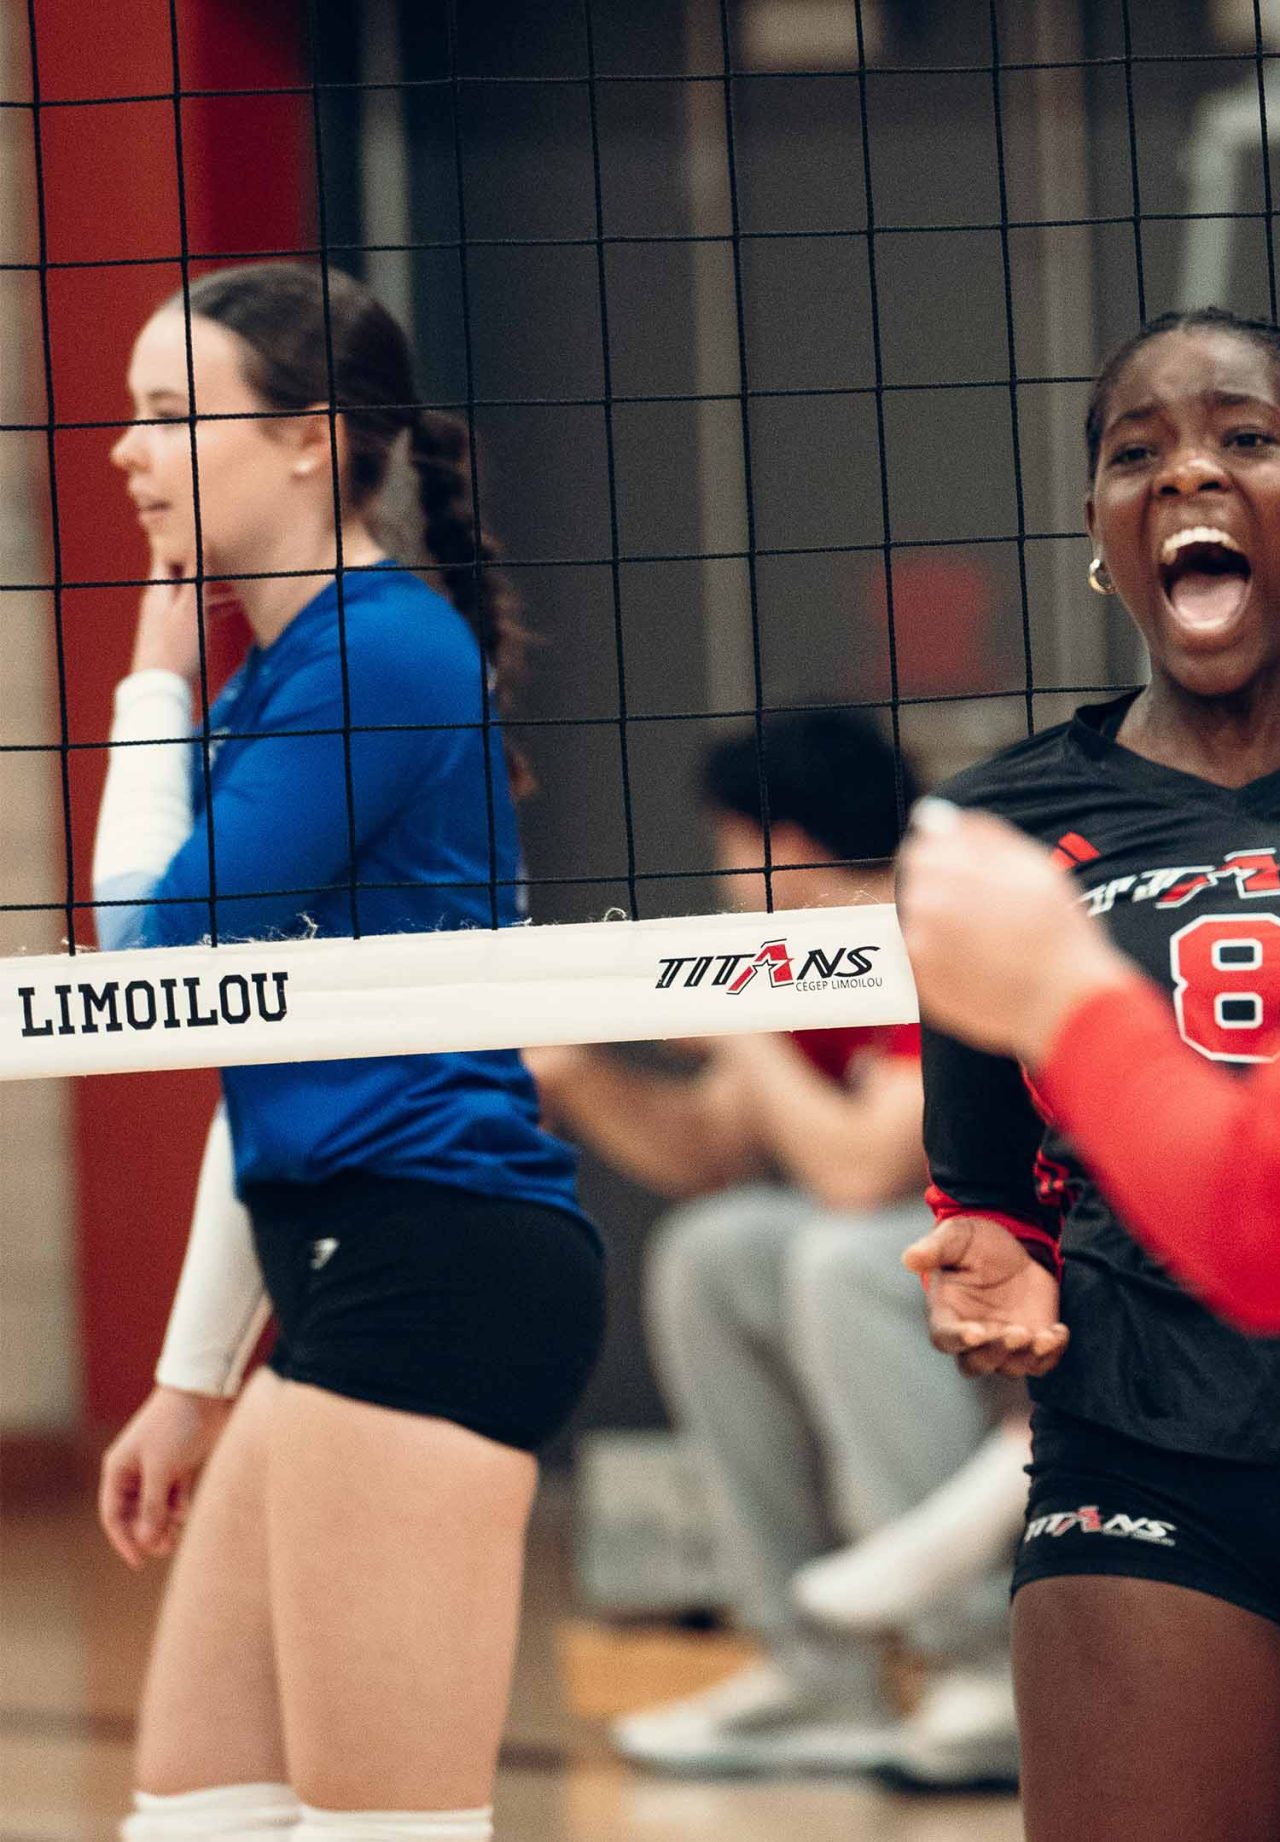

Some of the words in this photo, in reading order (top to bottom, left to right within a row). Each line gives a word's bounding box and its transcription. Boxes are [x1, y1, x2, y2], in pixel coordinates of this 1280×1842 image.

[655, 938, 881, 995] TITANS
[795, 980, 829, 992] CEGEP
[831, 977, 883, 990] LIMOILOU
[18, 972, 289, 1037] LIMOILOU
